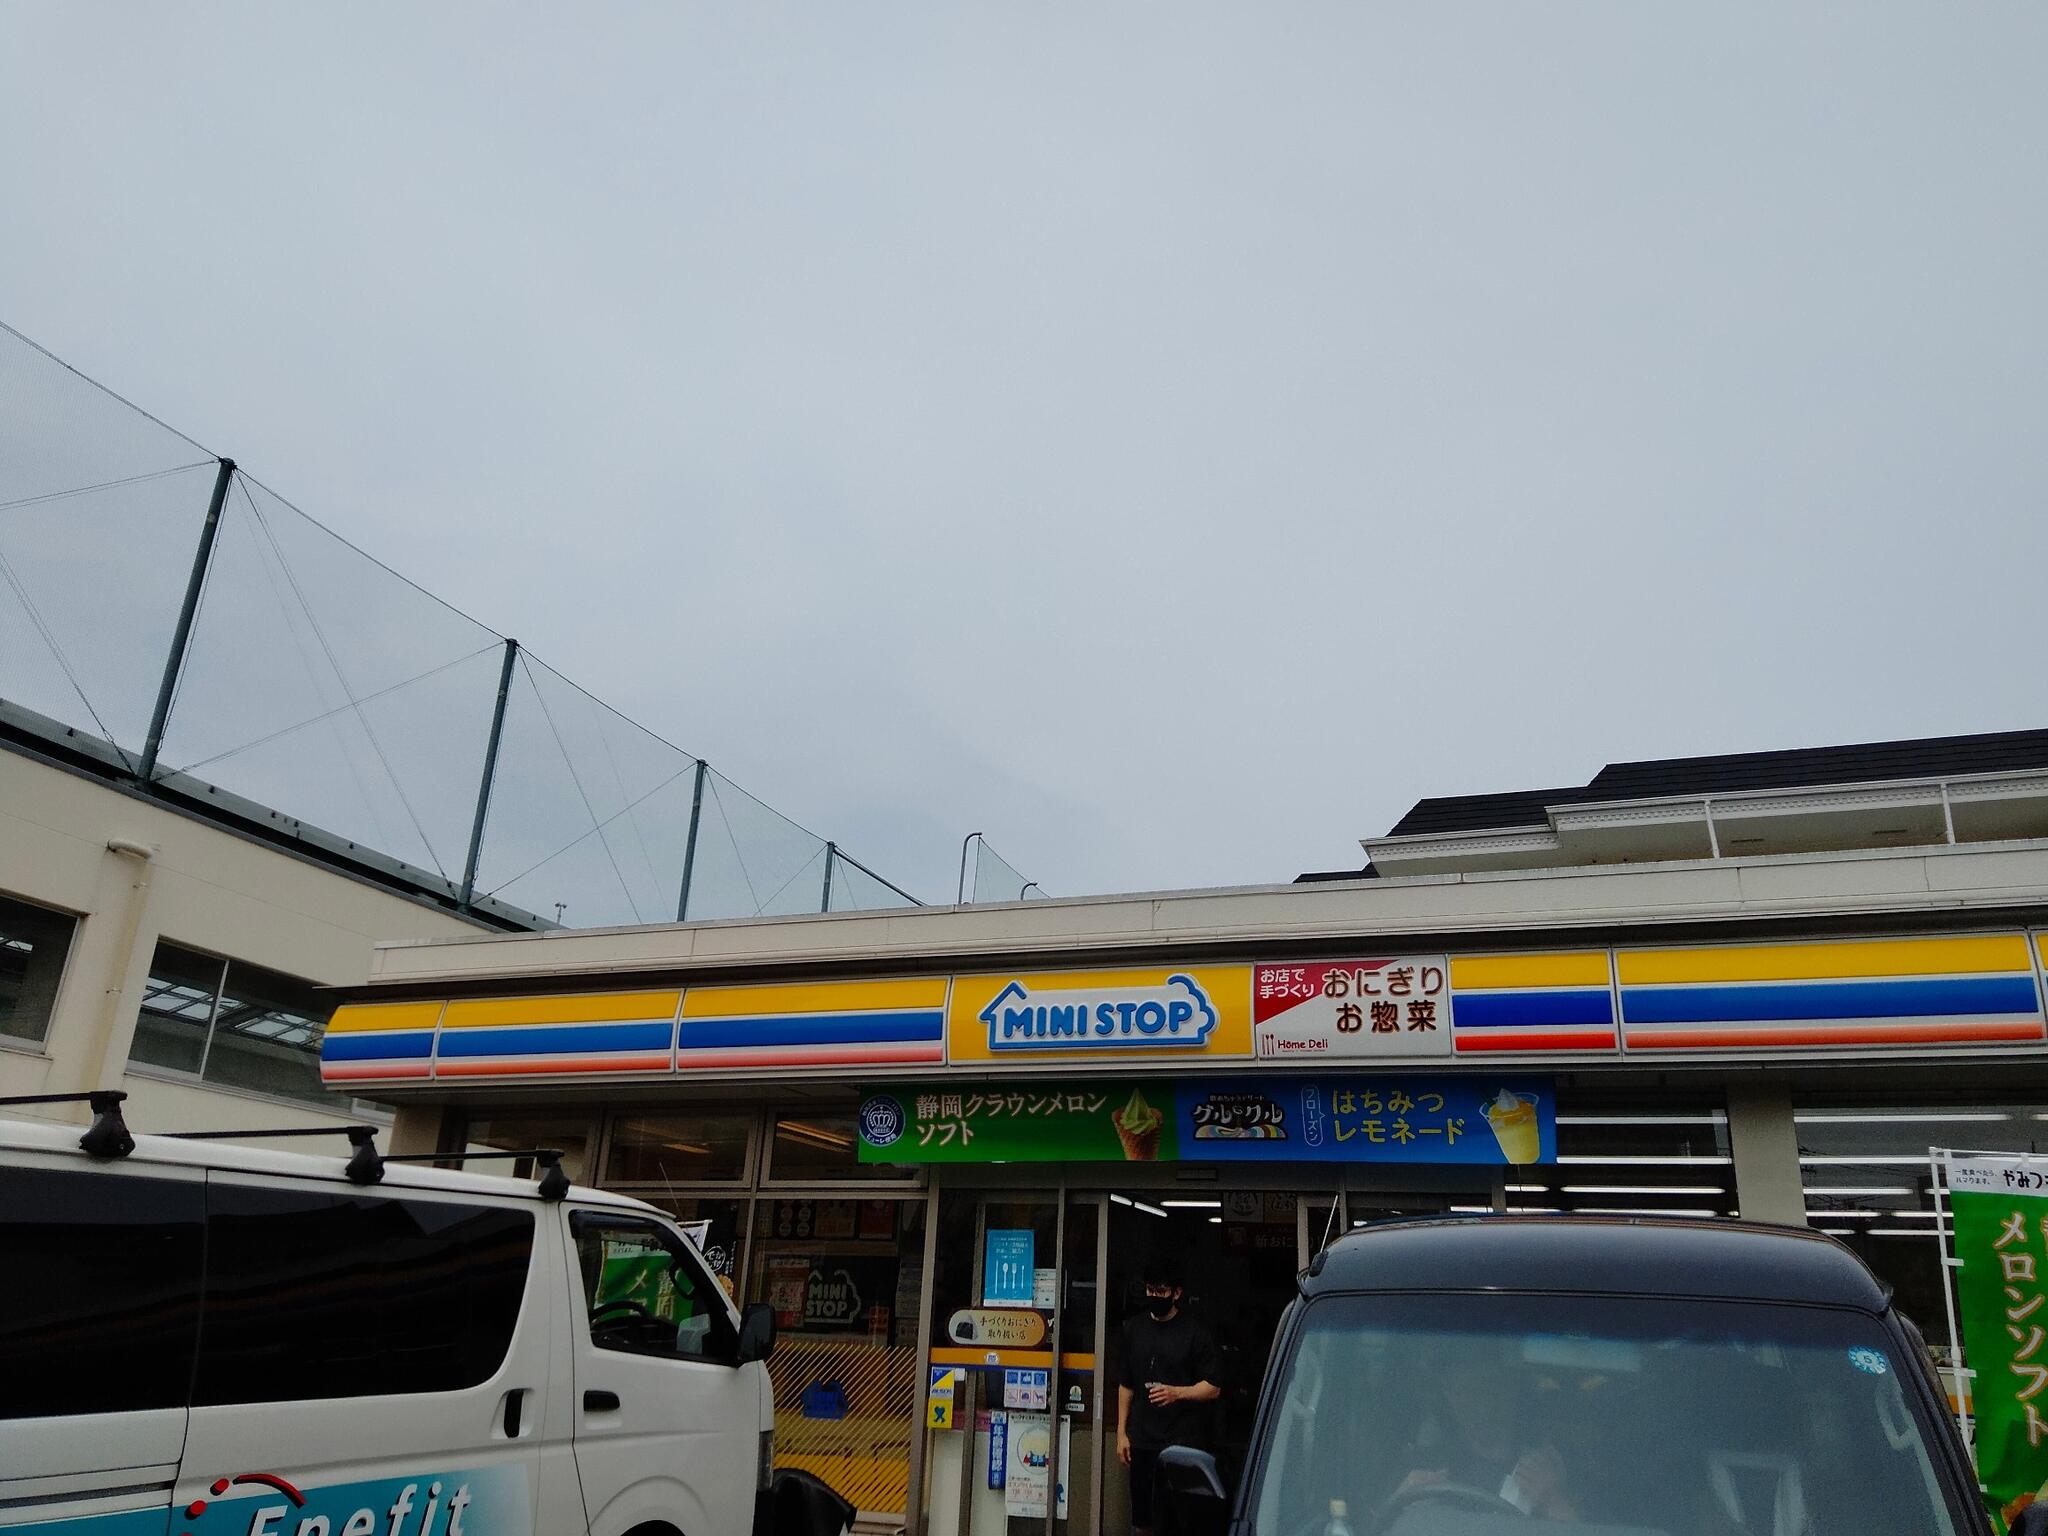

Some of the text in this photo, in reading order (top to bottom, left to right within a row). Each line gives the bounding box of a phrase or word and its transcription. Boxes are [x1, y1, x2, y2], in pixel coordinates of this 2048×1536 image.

[1260, 968, 1305, 983] お店で
[1322, 966, 1443, 998] おにぎり
[1259, 983, 1314, 999] 手づくり
[1003, 1001, 1193, 1038] MINI STOP
[1336, 1000, 1437, 1034] お惣菜
[1308, 1039, 1329, 1049] Deli
[915, 1091, 1107, 1120] 静岡クラウンメロン
[1305, 1088, 1319, 1142] フローズン
[1332, 1088, 1445, 1115] はちみつ
[916, 1120, 976, 1147] ソフト
[1333, 1116, 1466, 1146] レモネード
[2002, 1169, 2048, 1189] やみつ
[808, 1282, 848, 1300] MINI
[805, 1300, 849, 1318] STOP
